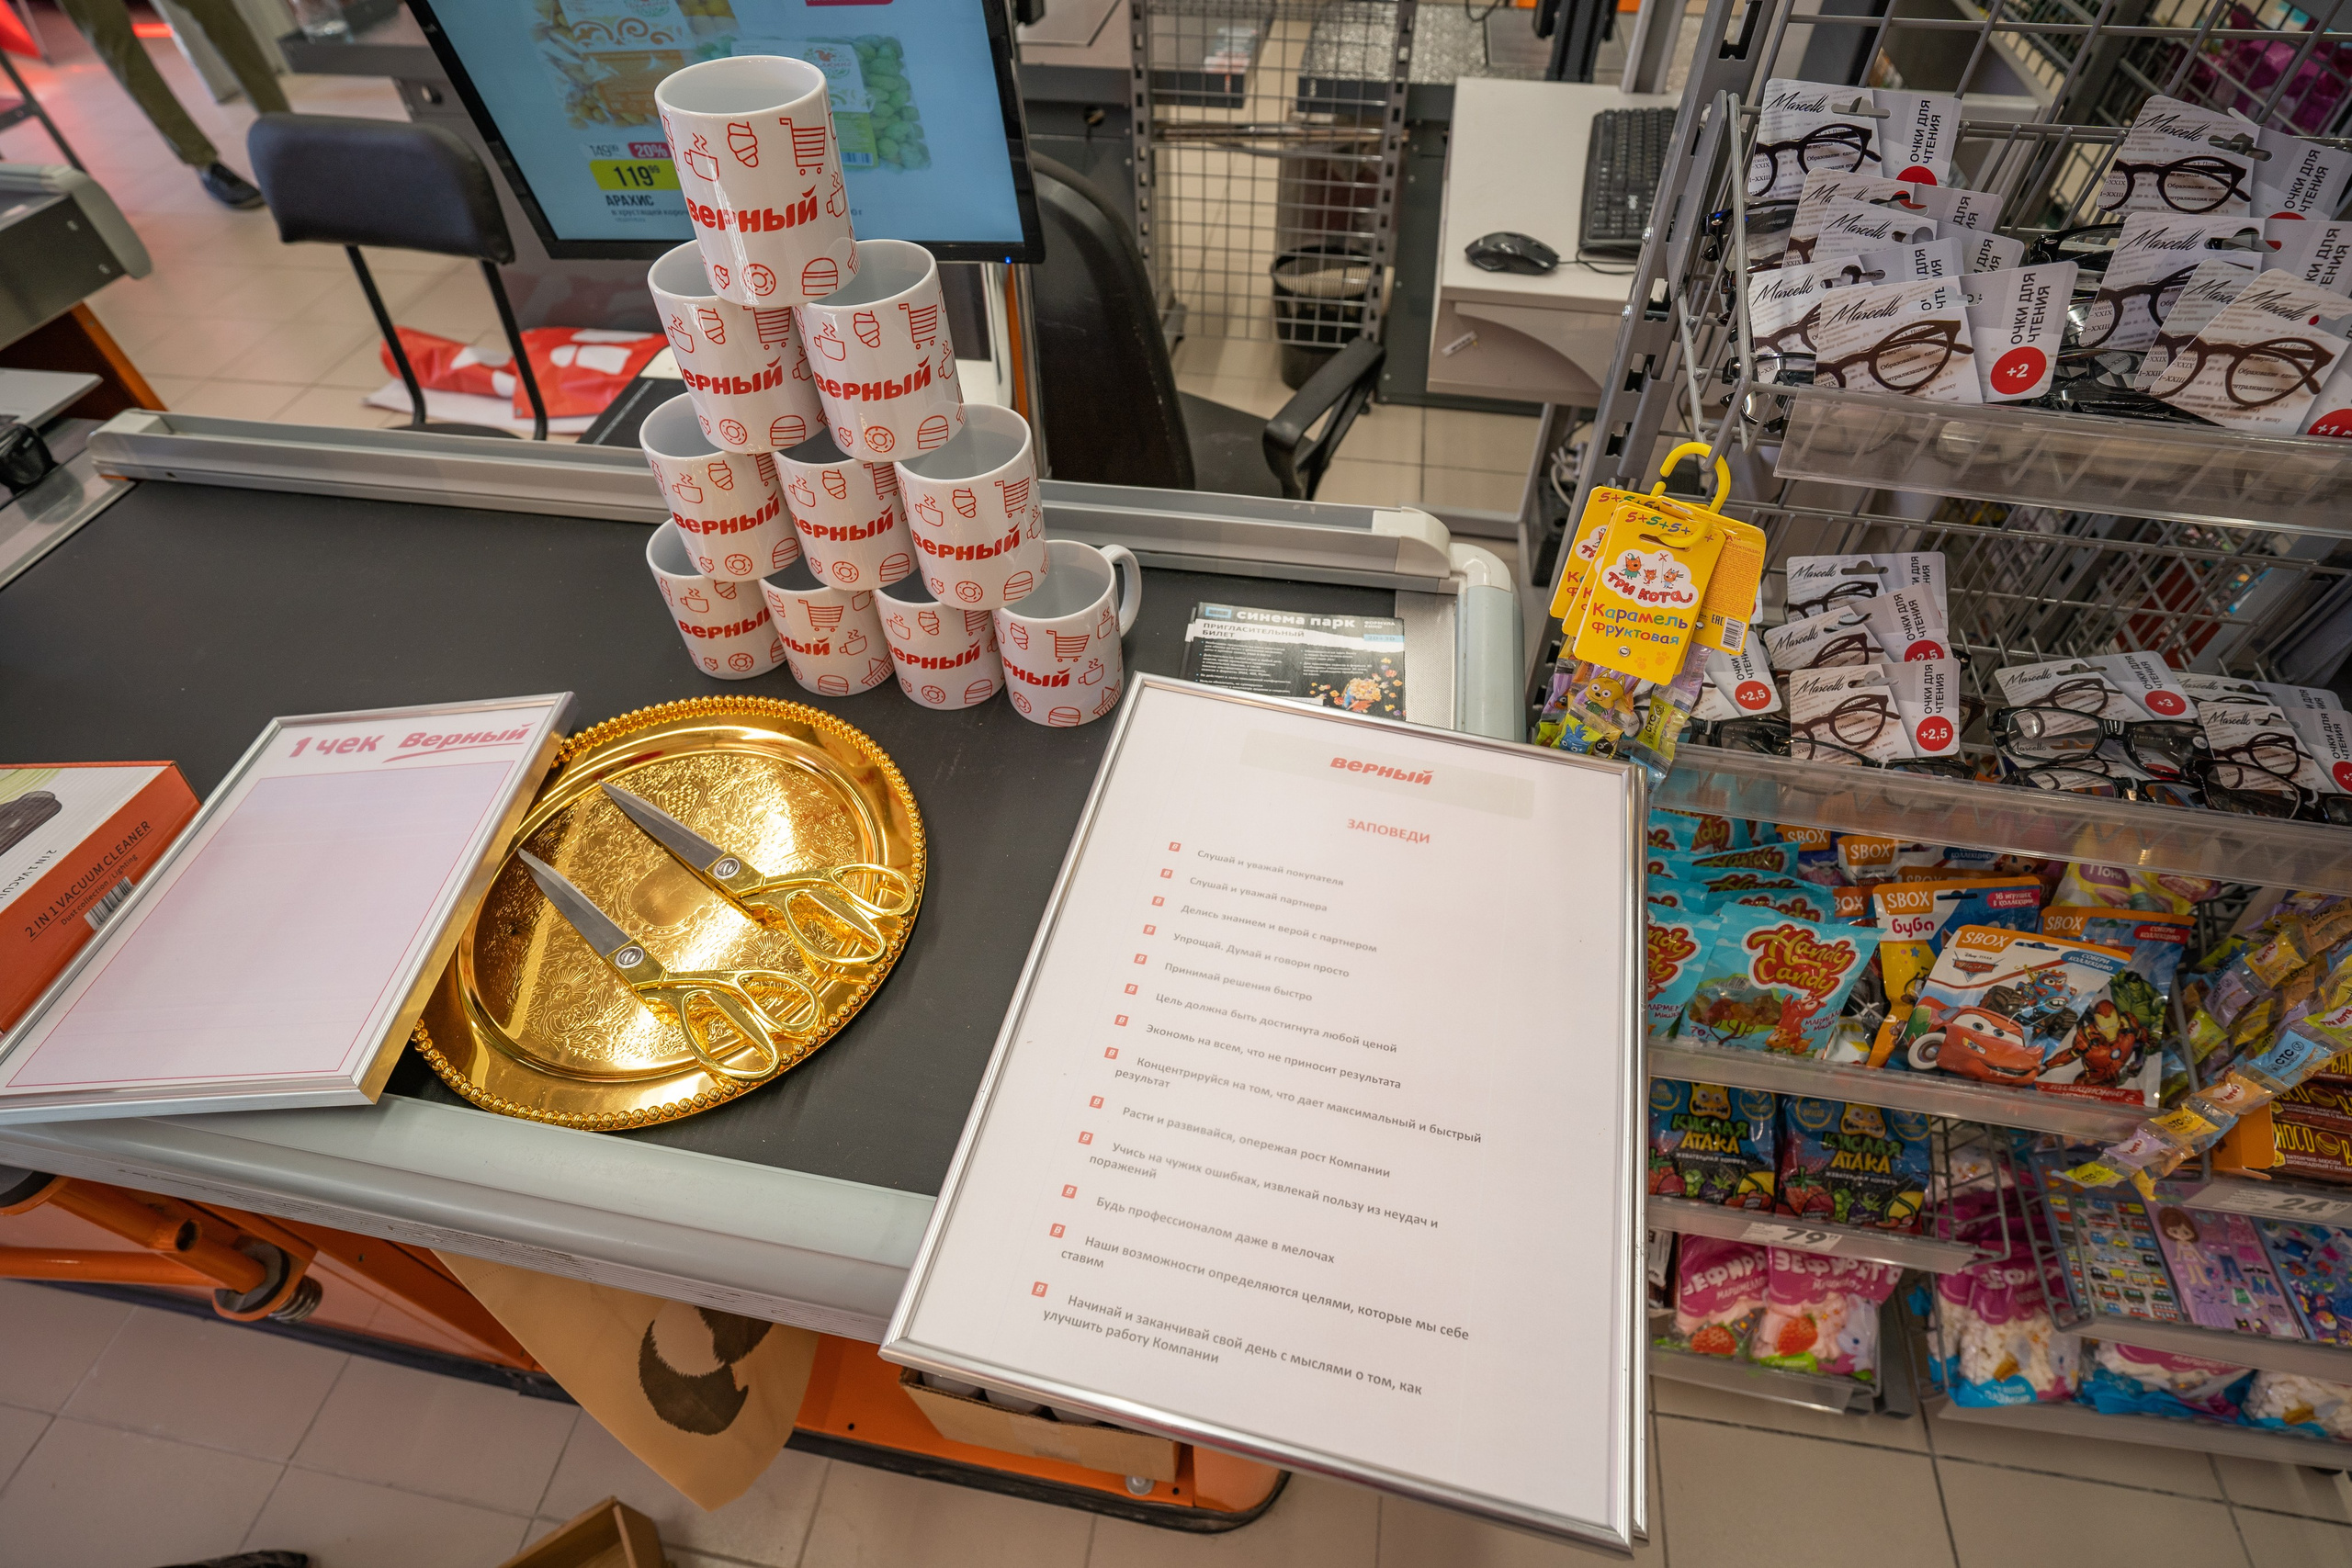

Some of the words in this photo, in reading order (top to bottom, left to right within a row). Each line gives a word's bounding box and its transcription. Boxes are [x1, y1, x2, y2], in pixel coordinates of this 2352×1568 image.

[1764, 91, 1829, 114] Marcello
[1917, 100, 1931, 128] ДЛЯ
[1923, 114, 1941, 164] ЧТЕНИЯ
[2134, 113, 2212, 142] Marcello
[1910, 130, 1926, 163] ОЧКИ
[2284, 176, 2307, 209] ОЧКИ
[2299, 149, 2321, 178] ДЛЯ
[2299, 166, 2329, 212] ЧТЕНИЯ
[605, 195, 655, 207] АРАХИС
[1824, 213, 1893, 240] Marcello
[2119, 227, 2206, 253] Marcello
[1752, 274, 1815, 307] Marcello
[2018, 272, 2037, 303] ДЛЯ
[1824, 294, 1904, 328] Marcello
[2027, 285, 2051, 344] ЧТЕНИЯ
[2233, 289, 2320, 321] Marcello
[2010, 305, 2030, 345] ОЧКИ
[677, 355, 783, 395] ерный
[2006, 363, 2030, 378] +2
[673, 490, 780, 536] верный
[911, 522, 1022, 561] верный
[1791, 563, 1836, 581] Marcello
[1592, 602, 1689, 629] Карамель
[1894, 593, 1908, 614] ДЛЯ
[1203, 623, 1305, 637] ПРИГЛАСИТЕЛЬНЫЙ
[1236, 610, 1306, 626] синема
[1310, 617, 1356, 630] парк
[1900, 614, 1916, 641] ОЧКИ
[1907, 599, 1926, 638] ЧТЕНИЯ
[1202, 630, 1236, 638] БИЛЕТ
[1772, 624, 1818, 655] Marcello
[1731, 658, 1745, 681] ОЧКИ
[1924, 664, 1934, 690] ДЛЯ
[2005, 668, 2052, 688] Marcello
[2134, 670, 2154, 690] ОЧКИ
[2140, 660, 2164, 689] ЧТЕНИЯ
[1739, 689, 1766, 702] +2,5
[1794, 674, 1844, 697] Marcello
[1936, 673, 1944, 714] ЧТЕНИЯ
[1924, 690, 1933, 715] ОЧКИ
[2207, 710, 2251, 726] Marcello
[2321, 713, 2335, 736] ДЛЯ
[288, 737, 313, 758] 1
[316, 735, 384, 755] чек
[398, 722, 536, 750] Верный
[1920, 728, 1948, 739] +2,5
[2334, 723, 2350, 761] ЧТЕНИЯ
[2327, 737, 2341, 760] ОЧКИ
[1330, 757, 1435, 785] верный
[1347, 818, 1430, 844] ЗАПОВЕДИ
[1787, 829, 1827, 844] SBOX
[1849, 842, 1891, 860] SBOX
[25, 926, 37, 939] 2
[33, 913, 50, 930] IN
[48, 905, 60, 917] 1
[56, 863, 105, 908] VACUUM
[103, 820, 152, 867] CLEANER
[1197, 850, 1236, 864] Слушай
[1247, 862, 1284, 874] уважай
[1285, 869, 1344, 886] покупателя
[61, 908, 79, 926] Dust
[77, 879, 109, 911] collection
[111, 853, 139, 881] Lighting
[1189, 876, 1228, 892] Слушай
[1239, 888, 1278, 901] уважай
[1280, 896, 1328, 912] партнера
[1886, 890, 1931, 908] SBOX
[1180, 905, 1219, 919] Делись
[1221, 914, 1267, 929] знанием
[1277, 925, 1309, 938] верой
[1319, 934, 1377, 953] партнером
[2045, 916, 2084, 931] SBOX
[1752, 928, 1851, 973] Handy
[1962, 931, 2008, 948] SBOX
[1172, 932, 1224, 951] Упрощай.
[1225, 944, 1262, 959] Думай
[1273, 956, 1311, 969] говори
[1313, 964, 1350, 978] просто
[2068, 955, 2113, 972] КОЛЛЕКЦИЮ
[2081, 953, 2109, 964] СОБЕРИ
[1164, 962, 1221, 982] Принимай
[1222, 976, 1272, 993] решения
[1273, 986, 1313, 1001] быстро
[1758, 956, 1837, 995] Candy
[1156, 993, 1182, 1006] Цель
[1184, 999, 1228, 1016] должна
[1230, 1010, 1258, 1023] быть
[1260, 1015, 1320, 1037] достигнута
[1321, 1031, 1360, 1045] любой
[1362, 1039, 1397, 1054] ценой
[1146, 1023, 1195, 1043] Экономь
[1213, 1041, 1244, 1055] всем,
[1283, 1056, 1338, 1075] приносит
[1339, 1068, 1401, 1089] результата
[1114, 1068, 1171, 1089] результат
[1136, 1056, 1230, 1087] Концентрируйся
[1296, 1096, 1325, 1109] дает
[1326, 1102, 1417, 1130] максимальный
[1429, 1123, 1482, 1144] быстрый
[1672, 1114, 1748, 1140] КИСЛАЯ
[1122, 1106, 1155, 1122] Расти
[1166, 1119, 1236, 1144] развивайся,
[1238, 1136, 1298, 1156] опережая
[1299, 1150, 1328, 1163] рост
[1329, 1155, 1391, 1179] Компании
[1680, 1131, 1740, 1155] АТАКА
[1089, 1156, 1158, 1179] поражений
[1830, 1151, 1892, 1174] АТАКА
[1112, 1142, 1146, 1160] Учись
[1165, 1157, 1203, 1173] чужих
[1204, 1168, 1261, 1189] ошибках,
[1263, 1180, 1320, 1201] извлекай
[1322, 1194, 1365, 1213] пользу
[1383, 1209, 1428, 1226] неудач
[1096, 1196, 1125, 1213] Будь
[1127, 1206, 1233, 1239] профессионалом
[1234, 1233, 1269, 1248] даже
[1281, 1244, 1335, 1264] мелочах
[1782, 1228, 1828, 1244] 79
[1060, 1250, 1104, 1269] ставим
[1084, 1235, 1120, 1254] Наши
[1122, 1247, 1206, 1276] возможности
[1208, 1269, 1299, 1299] определяются
[1301, 1292, 1354, 1314] целями,
[1357, 1305, 1413, 1327] которые
[1440, 1325, 1469, 1341] себе
[1043, 1309, 1103, 1334] улучшить
[1104, 1326, 1150, 1348] работу
[1151, 1336, 1219, 1364] Компании
[1067, 1294, 1123, 1318] Начинай
[1135, 1314, 1210, 1342] заканчивай
[1212, 1335, 1243, 1350] свой
[1244, 1343, 1278, 1359] день
[1289, 1354, 1352, 1379] мыслями
